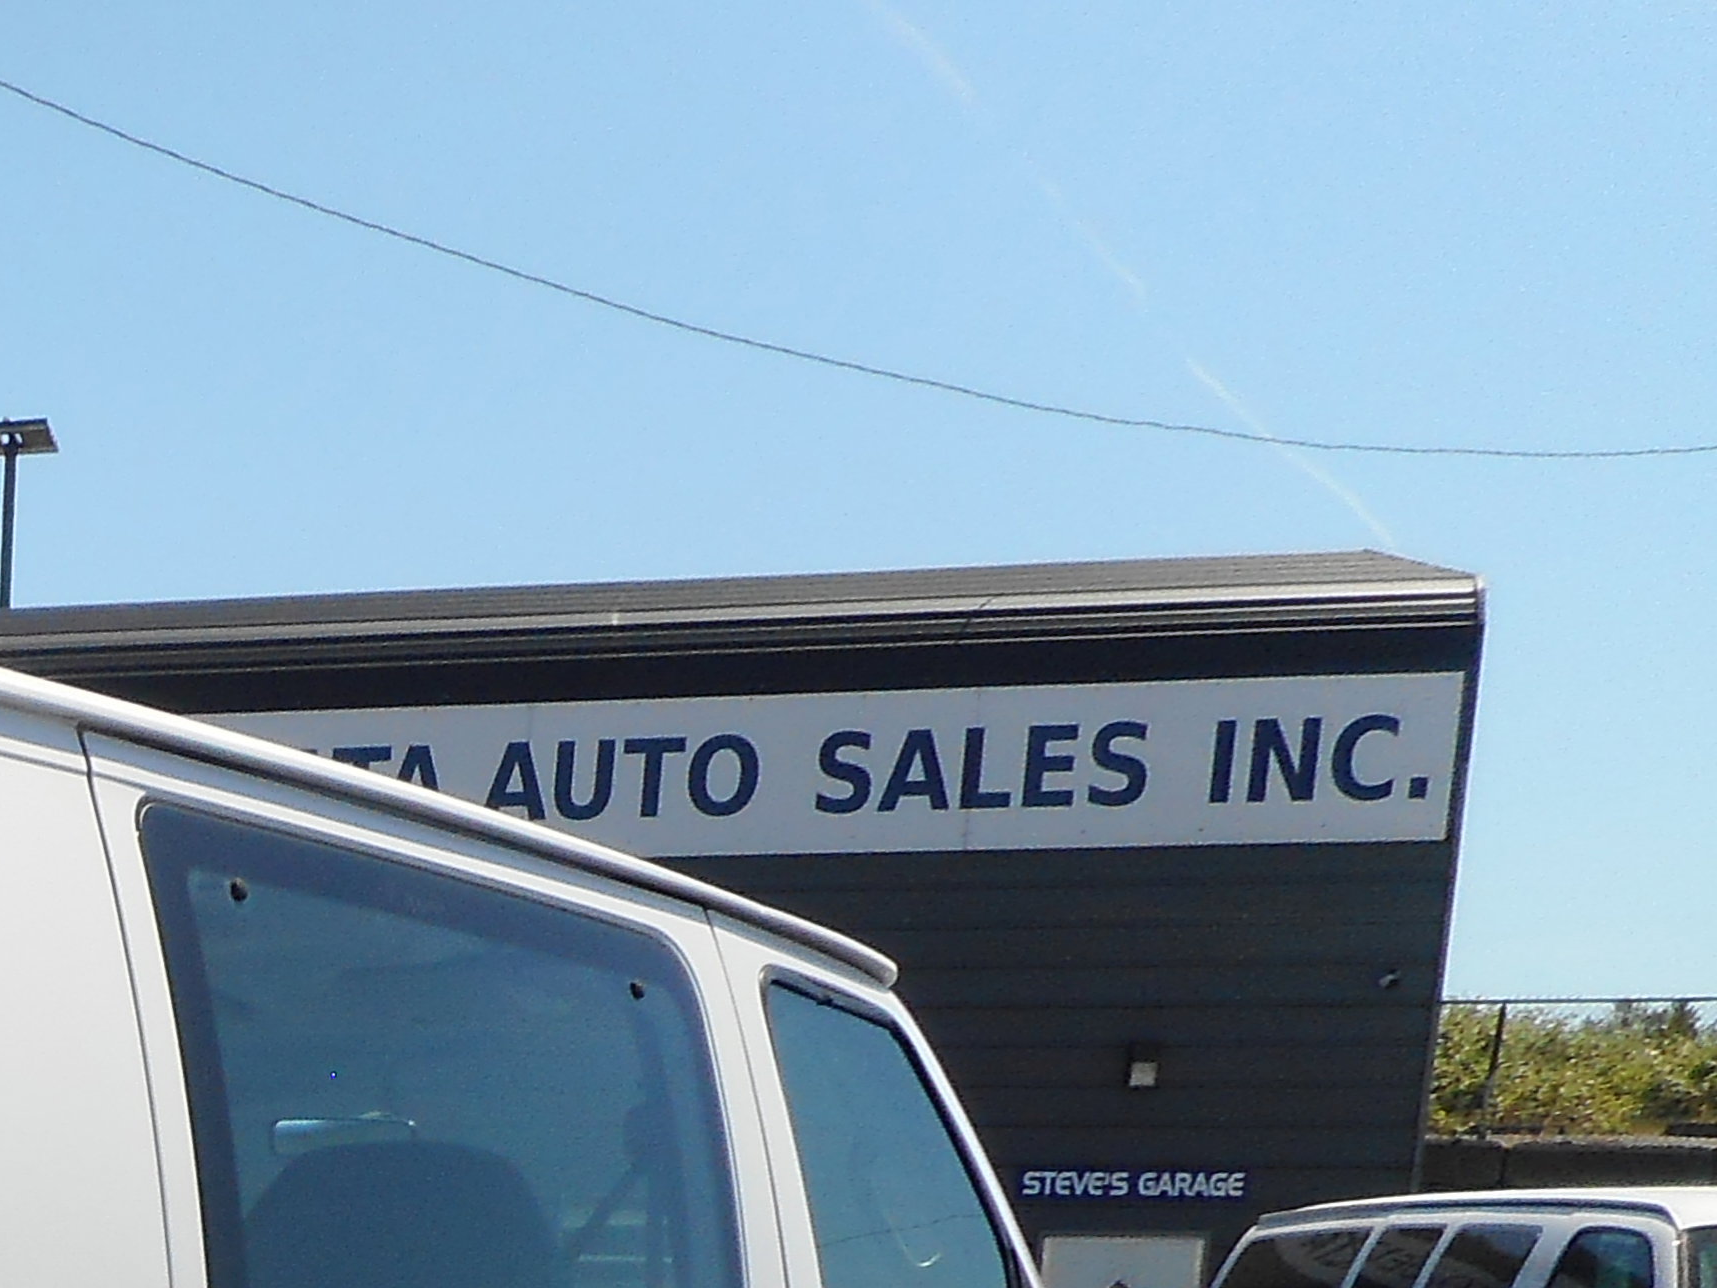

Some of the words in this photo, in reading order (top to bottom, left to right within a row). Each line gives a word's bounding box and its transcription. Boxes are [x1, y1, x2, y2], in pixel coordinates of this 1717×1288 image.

[484, 732, 761, 822] AUTO
[813, 719, 1149, 815] SALES
[1208, 714, 1430, 806] INC.
[1021, 1171, 1130, 1196] STEVE'S
[1137, 1172, 1247, 1197] GARAGE
